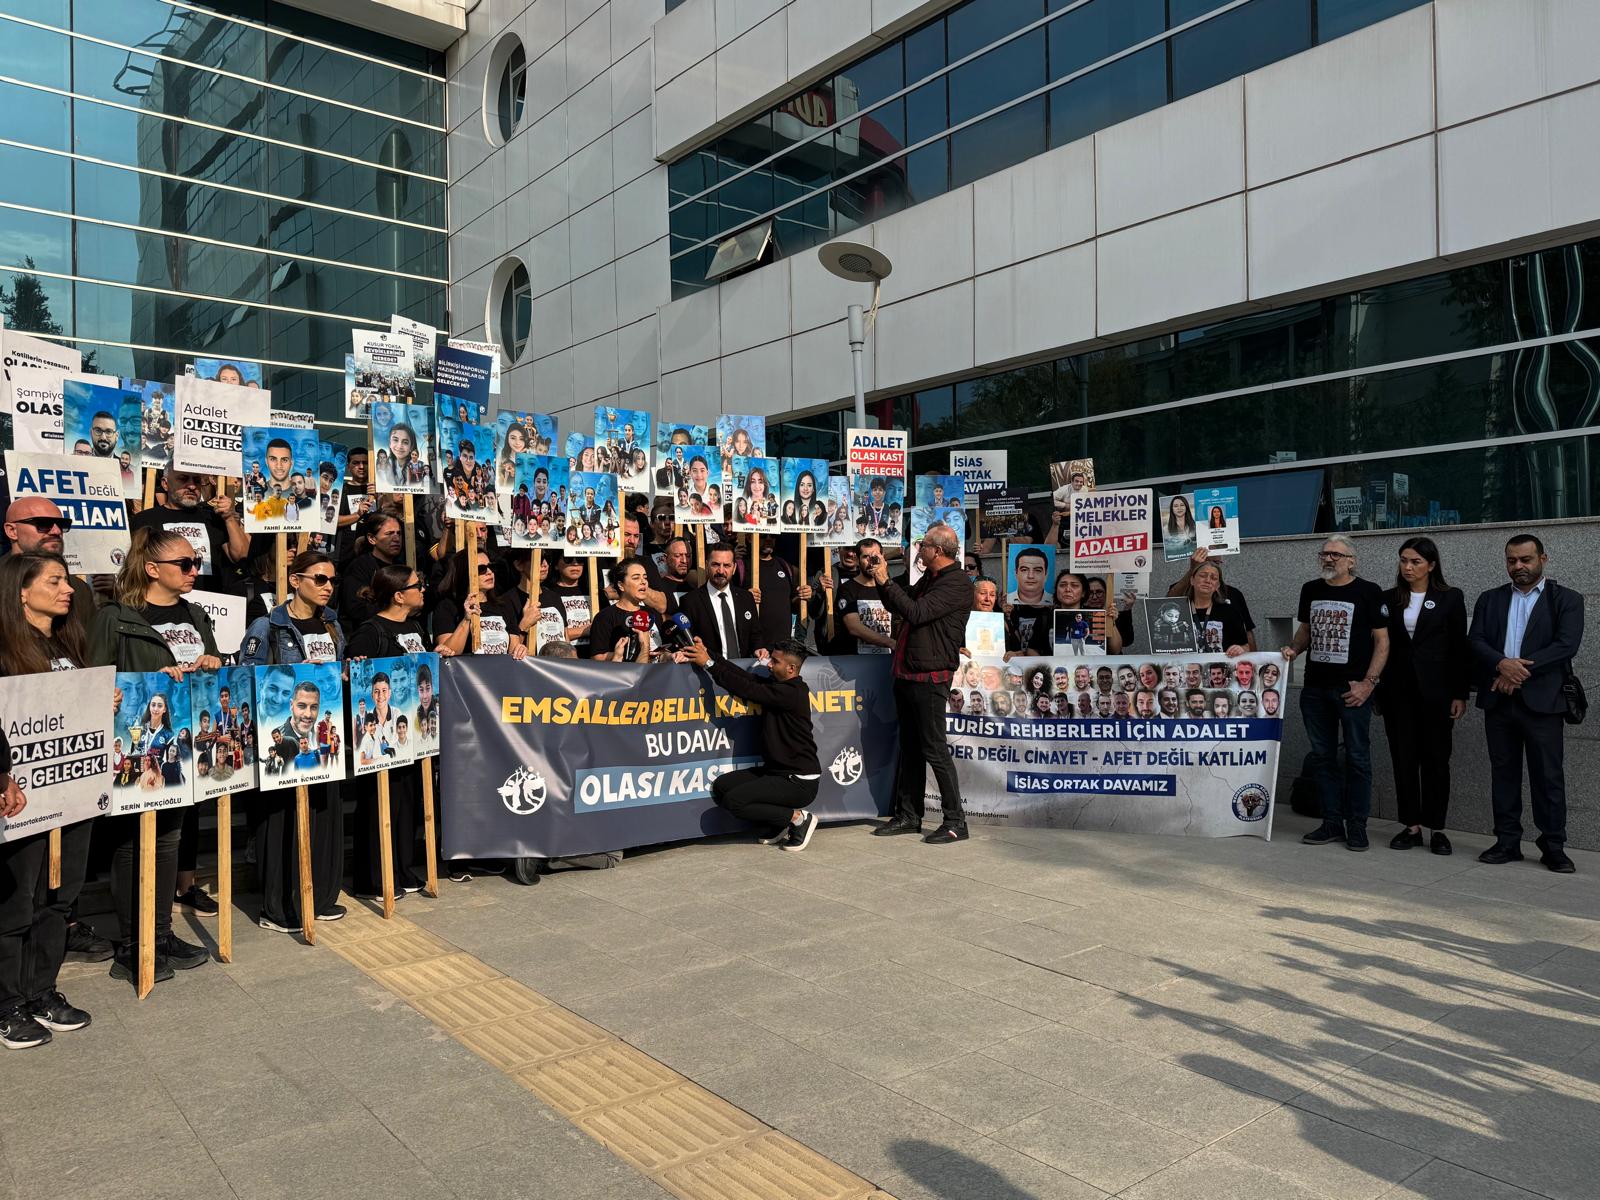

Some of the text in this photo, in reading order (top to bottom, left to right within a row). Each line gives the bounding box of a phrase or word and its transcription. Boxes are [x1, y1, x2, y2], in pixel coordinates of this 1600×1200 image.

[12, 350, 43, 364] Katillerin
[438, 359, 489, 375] BİLİRKİŞİ RAPORUNU
[436, 378, 461, 388] GELECEK
[437, 372, 469, 383] DURUŞMAYA
[16, 401, 64, 416] OLAS
[184, 403, 228, 419] Adalet
[184, 419, 242, 436] OLASI KA
[202, 437, 242, 452] GELEC
[853, 435, 903, 449] ADALET
[851, 451, 903, 462] OLASI KAST
[954, 455, 983, 467] İSİAS
[863, 466, 903, 477] GELECEK
[16, 467, 119, 497] AFET DEĞİL
[964, 482, 1004, 493] AVAMIZ
[1074, 494, 1148, 512] ŞAMPİYON
[61, 501, 124, 528] TLİAM
[1074, 508, 1147, 523] MELEKLER
[264, 524, 281, 532] FAHRİ
[1074, 524, 1103, 539] İÇİN
[1076, 535, 1144, 557] ADALET
[502, 696, 648, 726] EMSALLER
[650, 688, 712, 724] BELLİ,
[809, 689, 863, 715] NET:
[8, 713, 65, 738] Adalet
[945, 716, 1250, 742] TURİST REHBERLERİ İÇİN ADALET
[11, 731, 104, 765] OLASI KAST
[645, 727, 731, 758] BU DAVA
[977, 744, 1020, 763] DEĞİL
[1024, 746, 1088, 765] CİNAYET
[1102, 751, 1143, 766] AFET
[1146, 747, 1194, 766] DEĞİL
[1198, 748, 1267, 767] KATLİAM
[32, 755, 107, 787] GELECEK!
[357, 765, 376, 773] ATAKAN
[279, 773, 330, 786] PAMİR KONUKLU
[1014, 775, 1168, 793] İSİAS ORTAK DAVAMIZ
[205, 782, 249, 796] MUSTAFA SABANCI
[580, 771, 665, 806] OLASI
[120, 797, 182, 811] SERİN İPEKÇİOĞLU
[4, 811, 63, 831] #isiasortakdavamız
